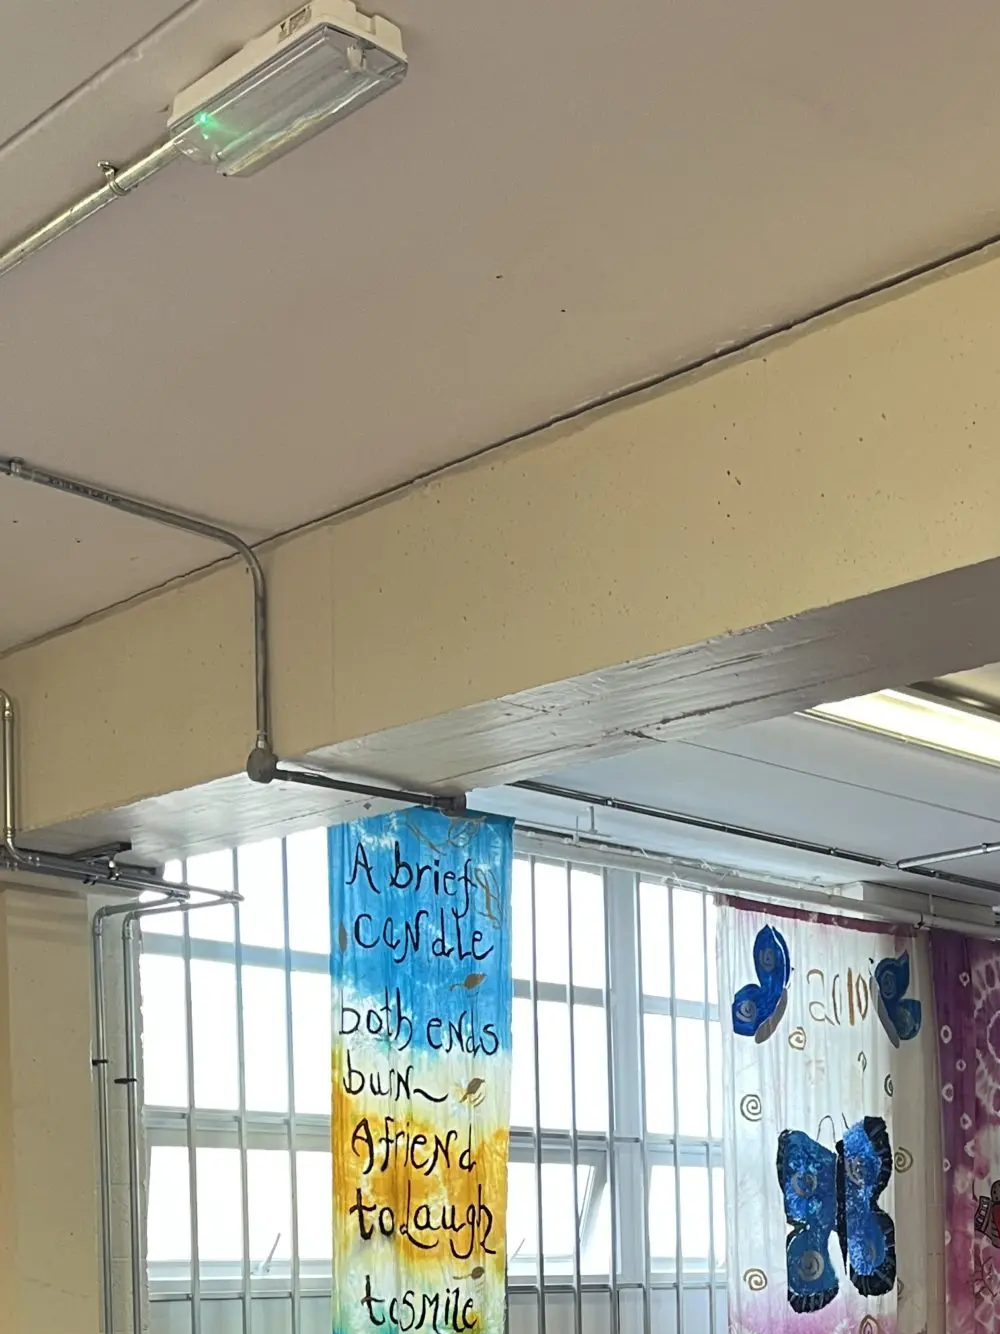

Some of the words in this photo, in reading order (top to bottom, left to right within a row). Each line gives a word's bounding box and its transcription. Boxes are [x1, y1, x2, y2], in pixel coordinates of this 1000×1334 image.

[346, 842, 381, 894] A
[389, 841, 477, 919] brief
[339, 986, 413, 1051] both
